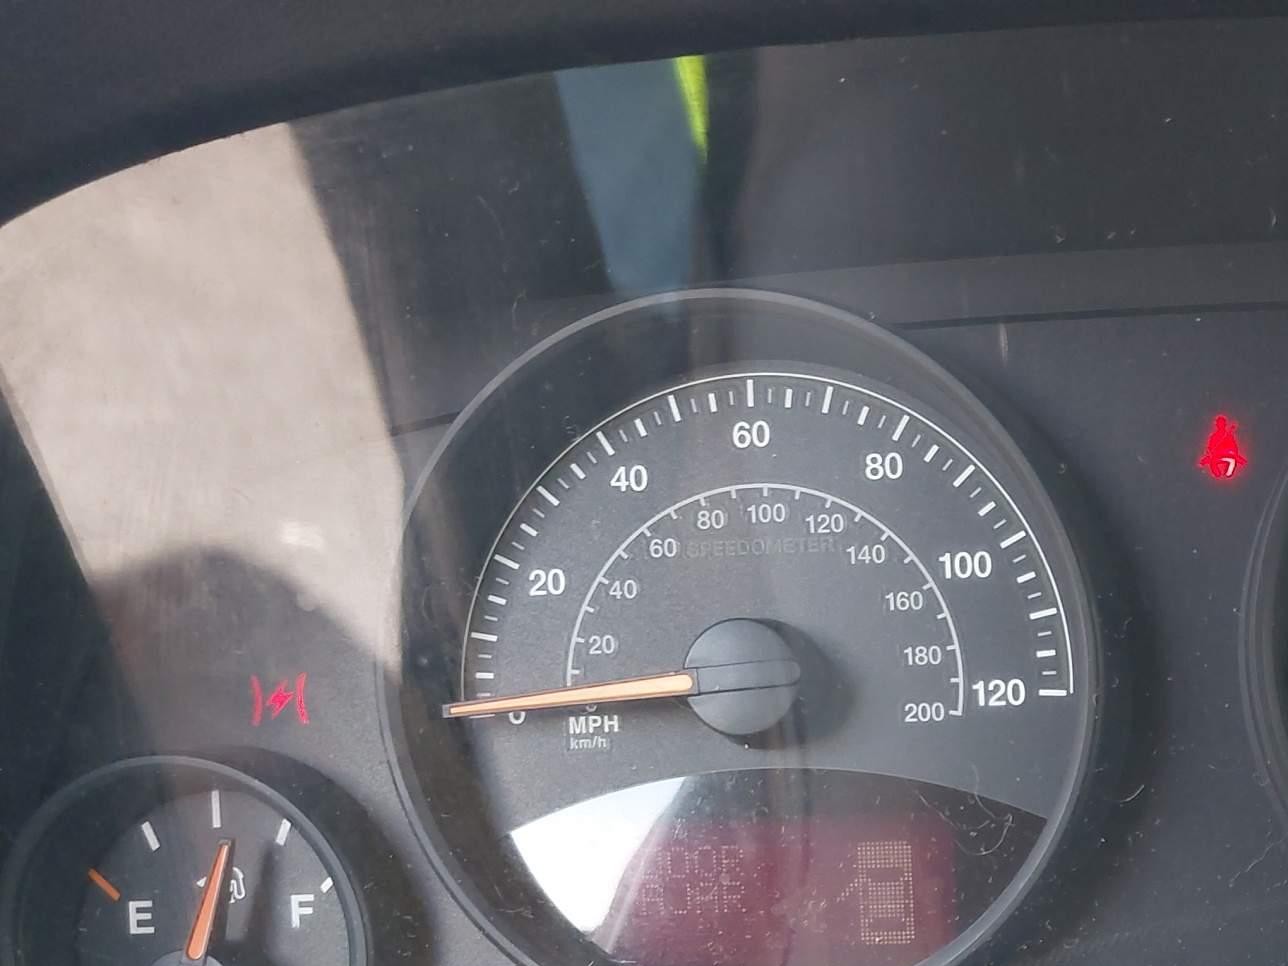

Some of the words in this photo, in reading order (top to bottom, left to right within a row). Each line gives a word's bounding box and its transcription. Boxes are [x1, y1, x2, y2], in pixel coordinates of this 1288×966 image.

[733, 421, 769, 448] 60
[865, 453, 902, 479] 80
[611, 465, 647, 491] 40
[698, 510, 724, 529] 80
[748, 504, 785, 522] 100
[806, 514, 843, 533] 120
[650, 538, 677, 557] 60
[684, 537, 834, 558] SPEEDOMETER
[847, 545, 885, 564] 140
[939, 551, 991, 578] 100
[529, 569, 565, 596] 20
[608, 580, 637, 598] 40
[886, 591, 922, 610] 160
[589, 635, 615, 654] 20
[904, 646, 941, 665] 180
[972, 679, 1025, 706] 120
[905, 703, 944, 722] 200
[569, 715, 619, 734] MPH
[569, 735, 608, 749] km/h
[129, 901, 154, 934] E
[291, 894, 314, 928] F
